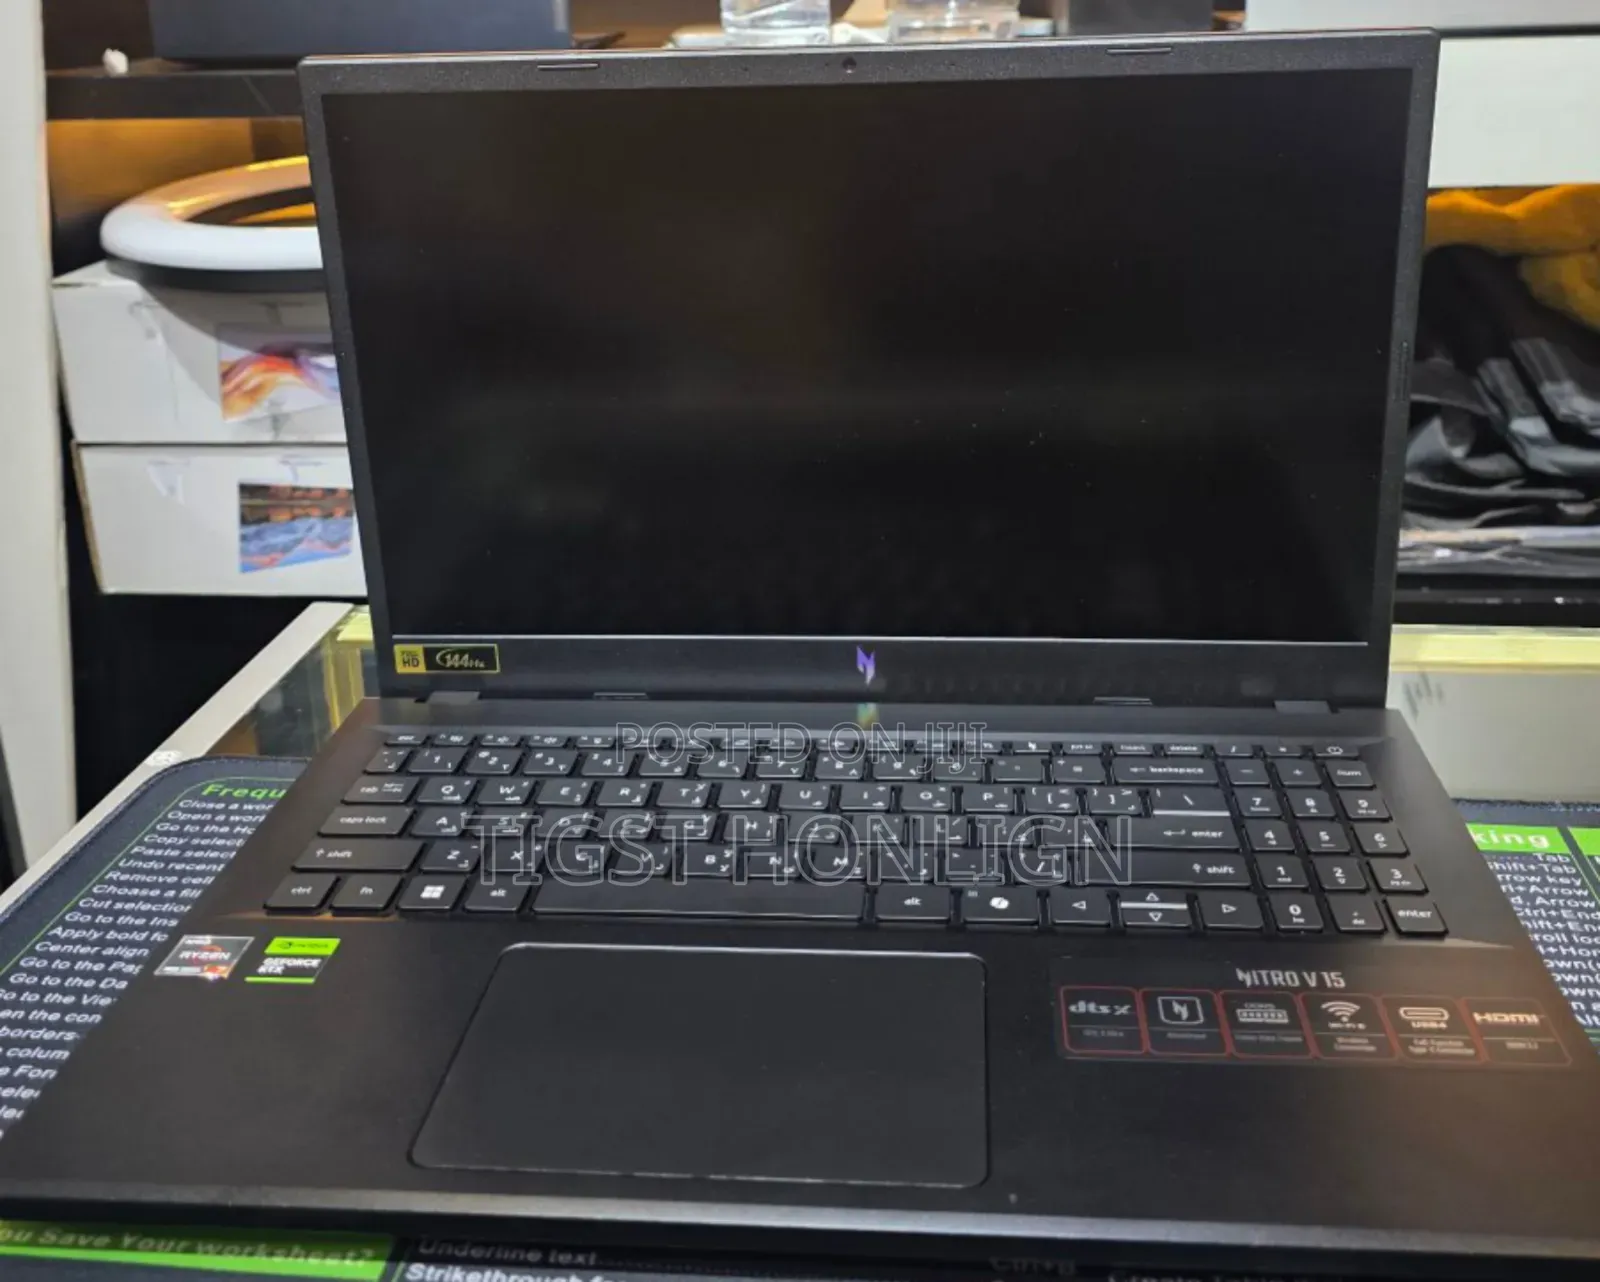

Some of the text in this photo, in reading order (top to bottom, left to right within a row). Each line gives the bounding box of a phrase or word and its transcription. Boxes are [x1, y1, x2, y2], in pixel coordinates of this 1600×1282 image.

[201, 783, 286, 799] Frequ
[178, 799, 226, 810] Close
[168, 810, 212, 821] Open
[155, 822, 180, 832] Go
[184, 824, 200, 832] to
[203, 824, 230, 833] the
[144, 834, 188, 846] Copy
[130, 845, 181, 857] Paste
[118, 858, 164, 870] Undo
[104, 871, 178, 884] Remove
[78, 896, 112, 909] Cut
[64, 911, 91, 922] Go
[95, 914, 114, 925] to
[116, 915, 147, 926] the
[48, 925, 104, 942] Apply
[105, 930, 150, 942] bold
[35, 941, 150, 960] Center align
[19, 957, 49, 969] Go
[52, 958, 72, 970] to
[74, 960, 106, 972] the
[9, 973, 38, 985] Go
[41, 975, 62, 987] to
[64, 976, 97, 989] the
[1235, 967, 1347, 989] NITRO V 15
[19, 991, 40, 1003] to
[43, 992, 76, 1005] the
[28, 1009, 61, 1022] the
[1472, 1011, 1540, 1025] HDMI
[39, 1227, 112, 1248] Save
